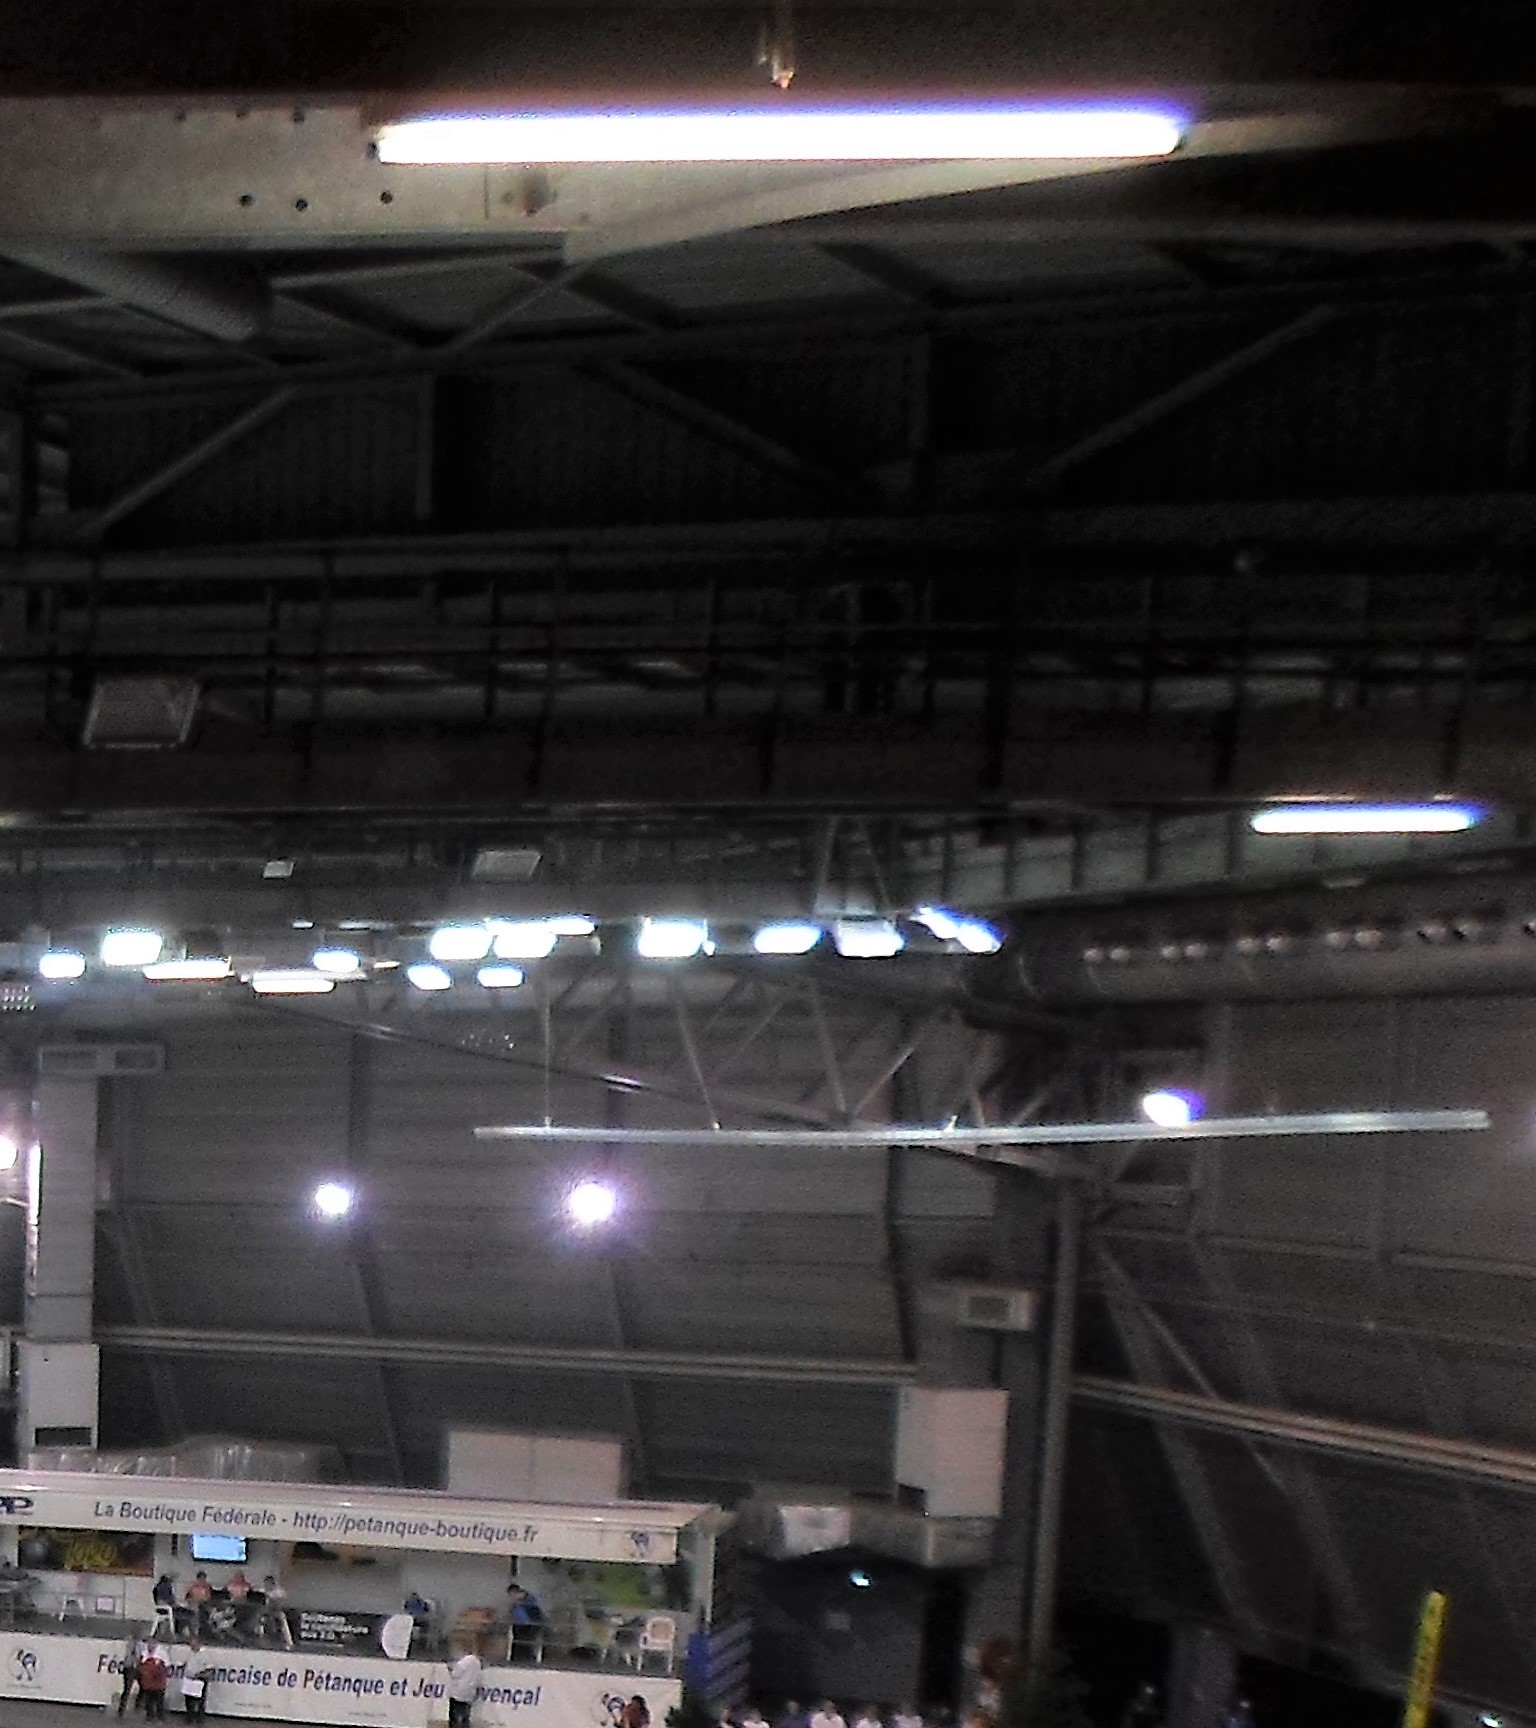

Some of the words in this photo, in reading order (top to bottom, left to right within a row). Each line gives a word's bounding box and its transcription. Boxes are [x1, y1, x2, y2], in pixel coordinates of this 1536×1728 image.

[94, 1501, 114, 1517] La
[119, 1502, 197, 1525] Boutique
[201, 1505, 276, 1526] Fédérale
[293, 1511, 538, 1544] http://petanque-boutique.fr
[277, 1667, 296, 1688] de
[303, 1669, 385, 1697] Pétanque
[390, 1679, 408, 1697] et
[412, 1678, 445, 1698] Jeu
